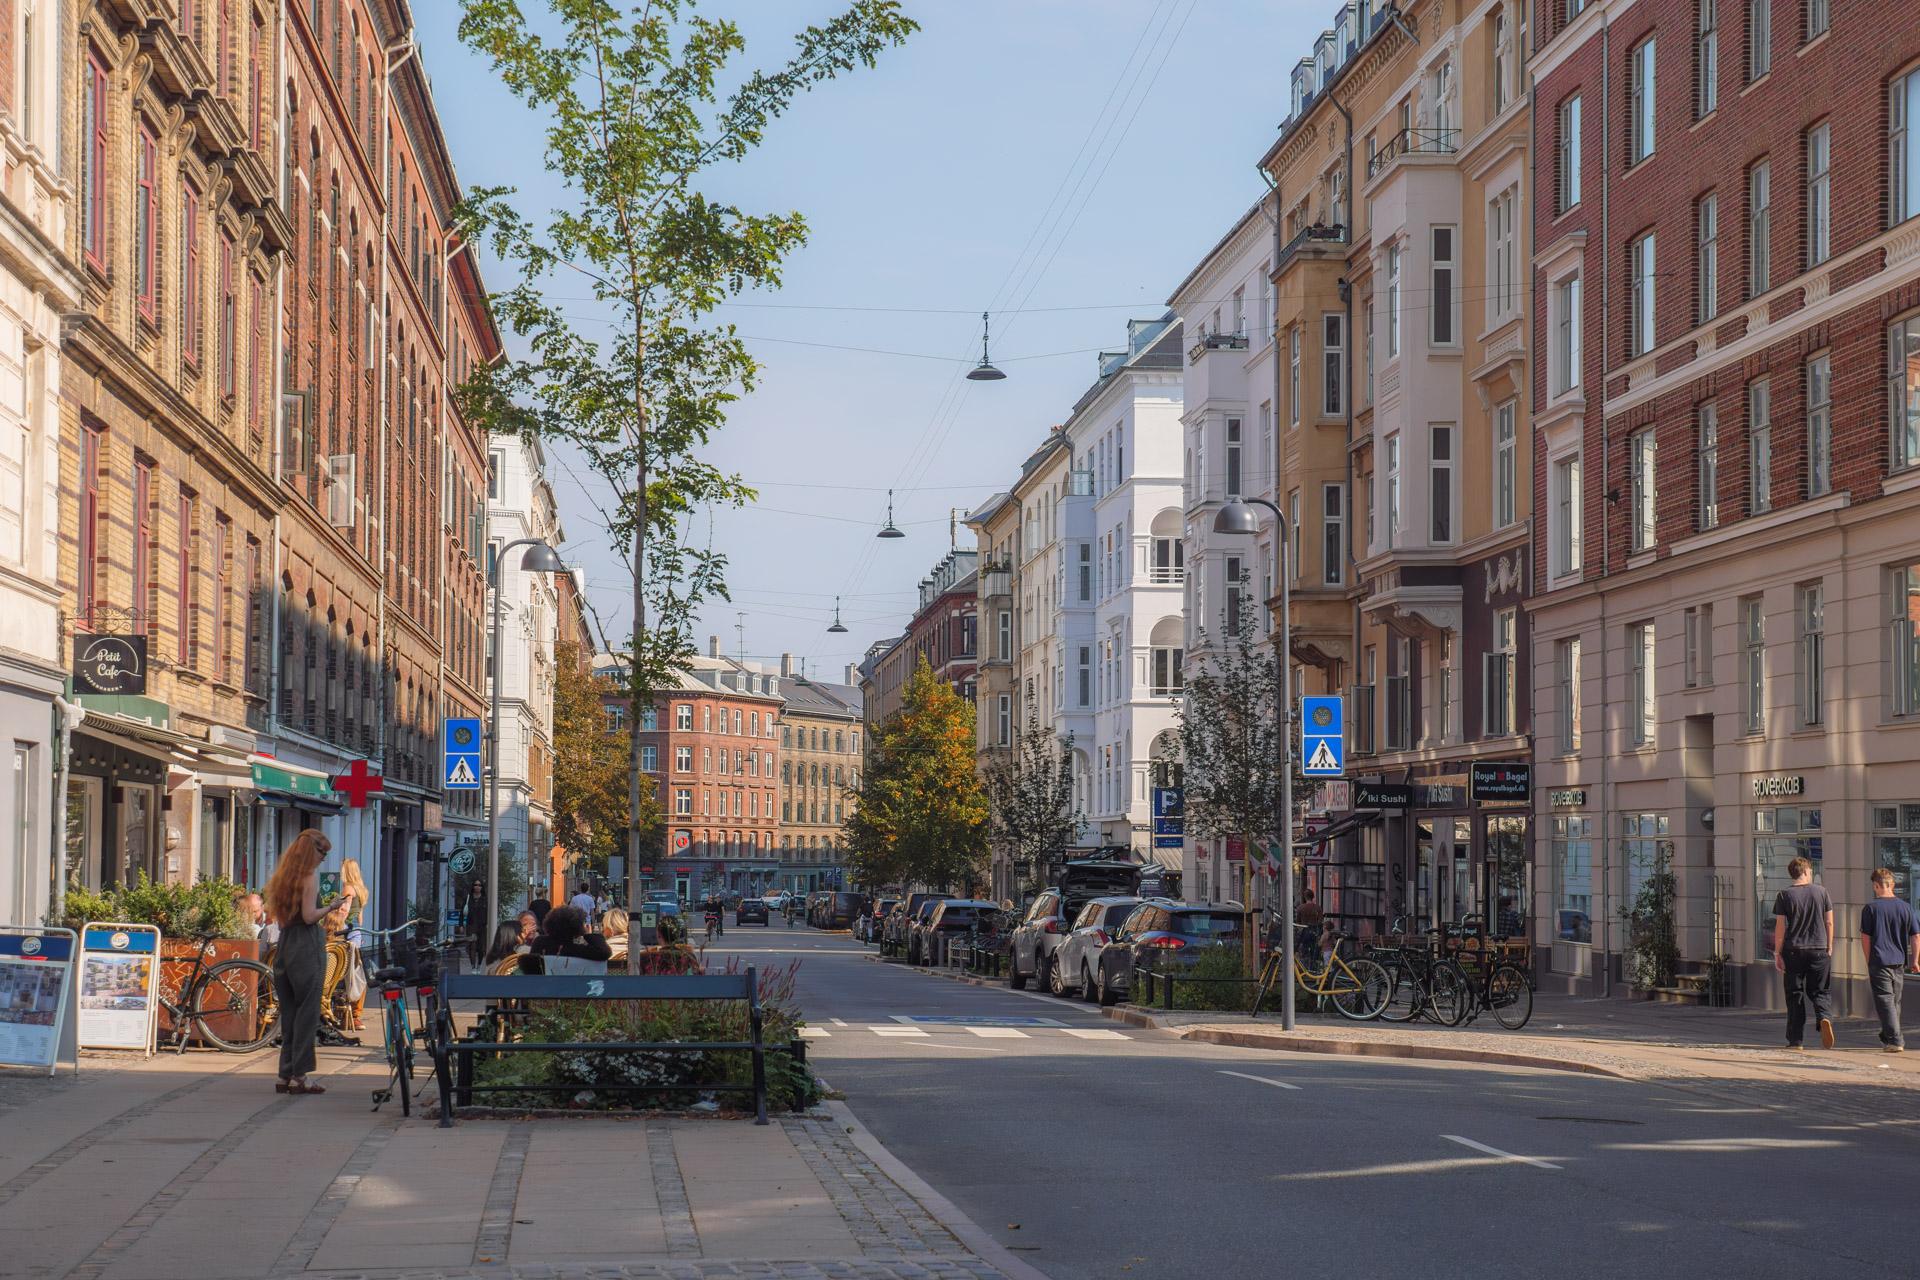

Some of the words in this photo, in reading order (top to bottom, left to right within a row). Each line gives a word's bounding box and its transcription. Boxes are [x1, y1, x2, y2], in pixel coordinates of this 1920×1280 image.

[97, 648, 121, 661] Petit
[1506, 771, 1528, 783] Bagel
[1368, 795, 1379, 803] Iki
[1381, 794, 1407, 803] Sushi
